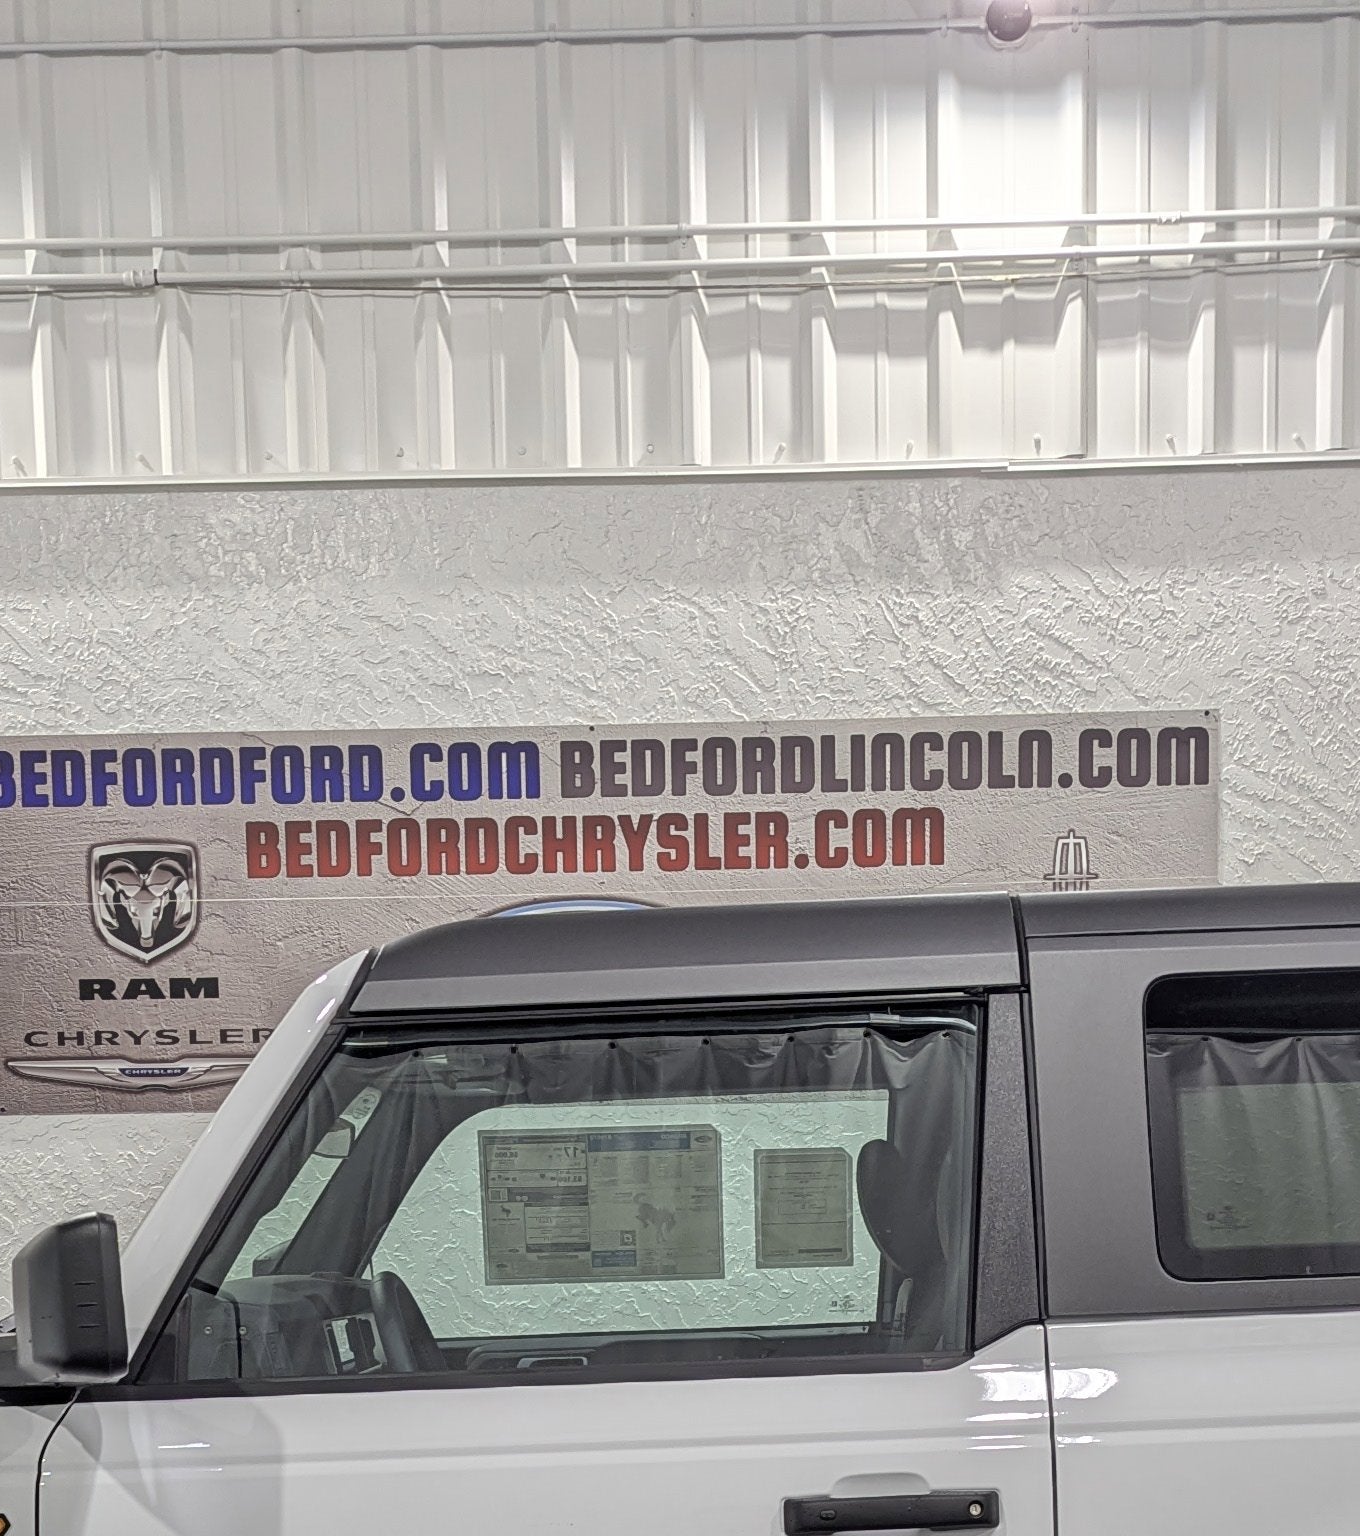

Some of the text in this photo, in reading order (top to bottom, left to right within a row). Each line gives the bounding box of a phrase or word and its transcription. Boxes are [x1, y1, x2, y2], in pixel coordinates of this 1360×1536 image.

[559, 726, 1210, 799] BEDFORDLINCOLN.COM
[246, 807, 945, 878] BEDFORDCHRYSLER.COM
[78, 976, 220, 1001] RAM
